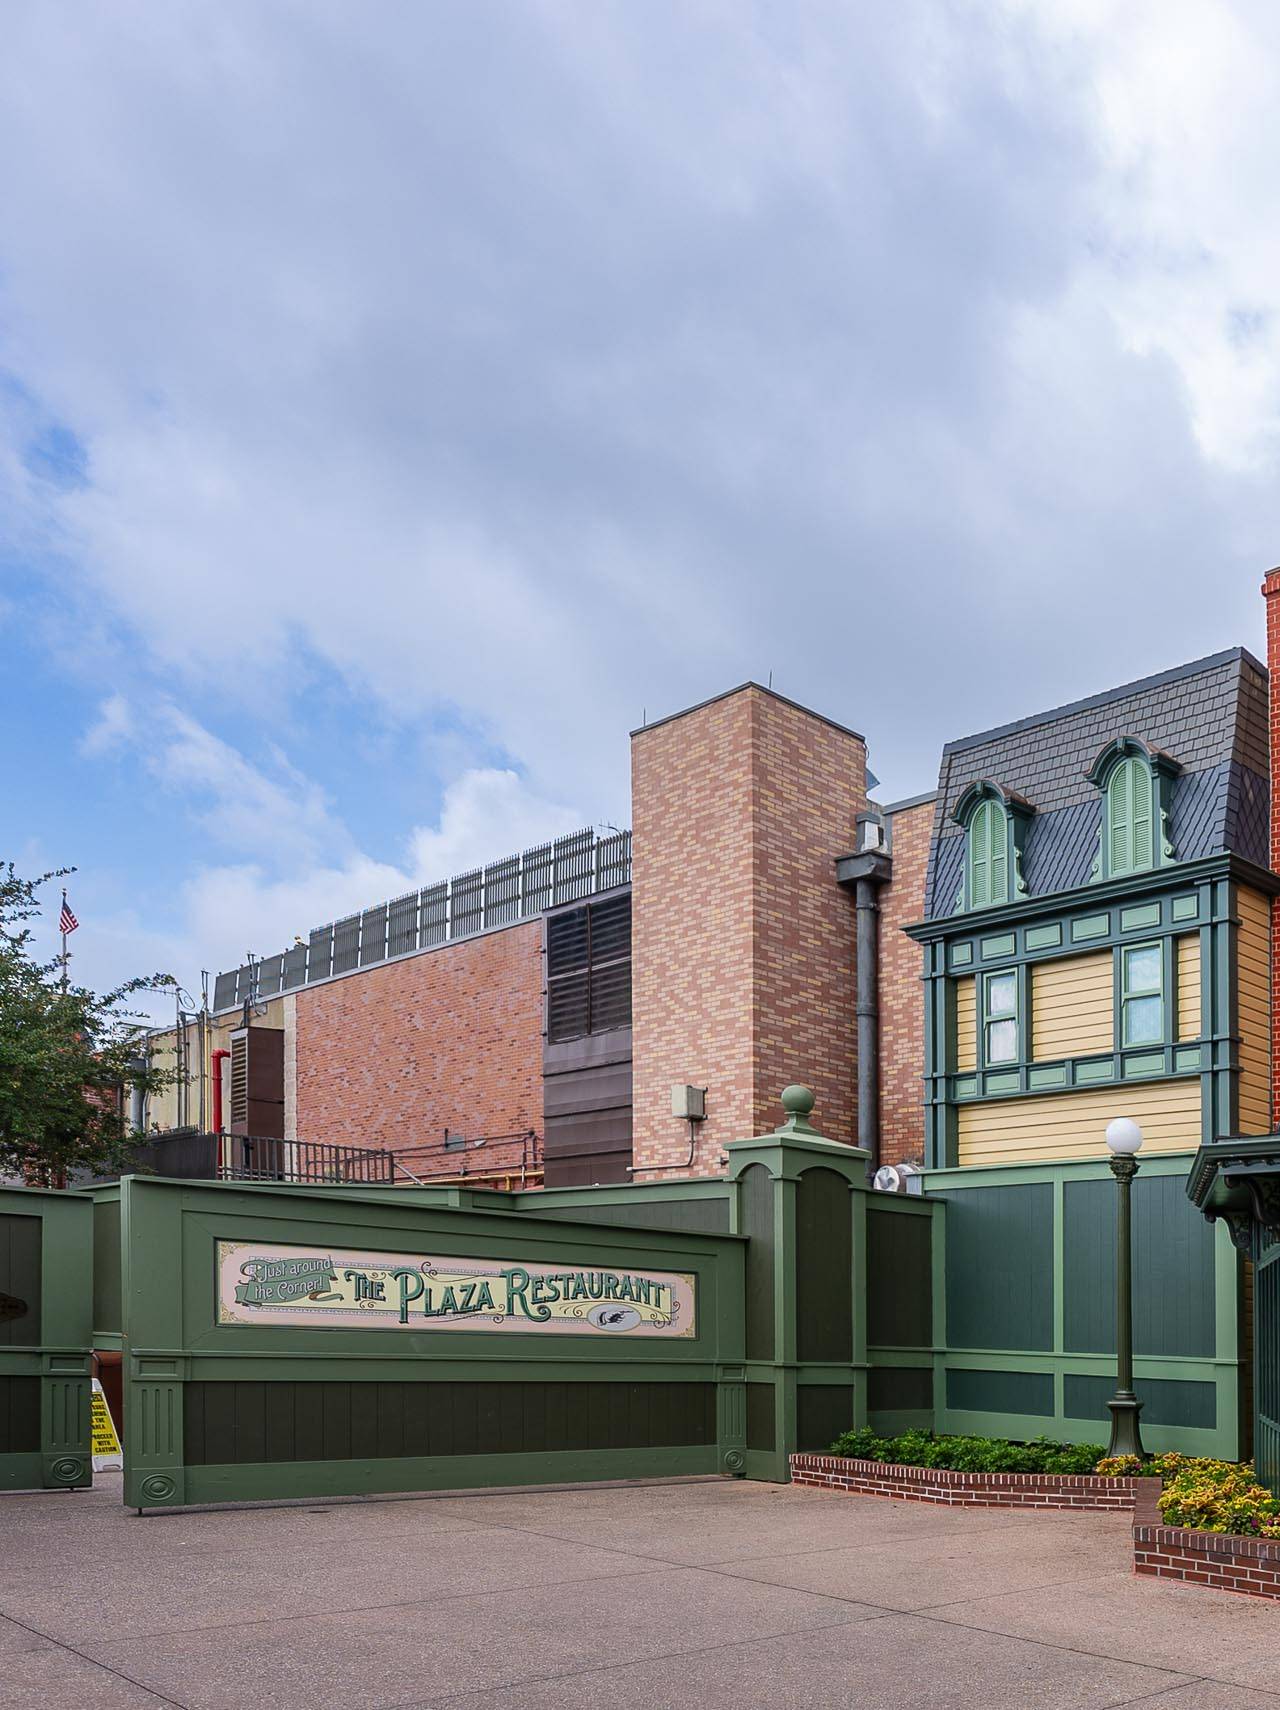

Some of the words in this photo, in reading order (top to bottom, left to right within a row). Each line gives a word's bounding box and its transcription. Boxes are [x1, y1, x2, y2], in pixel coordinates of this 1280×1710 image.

[259, 1263, 287, 1282] Just
[289, 1255, 332, 1274] around
[255, 1285, 273, 1299] the
[278, 1276, 323, 1300] Corner!
[344, 1270, 386, 1302] THE
[388, 1267, 495, 1324] PLAZA
[500, 1267, 665, 1322] RESTAURANT
